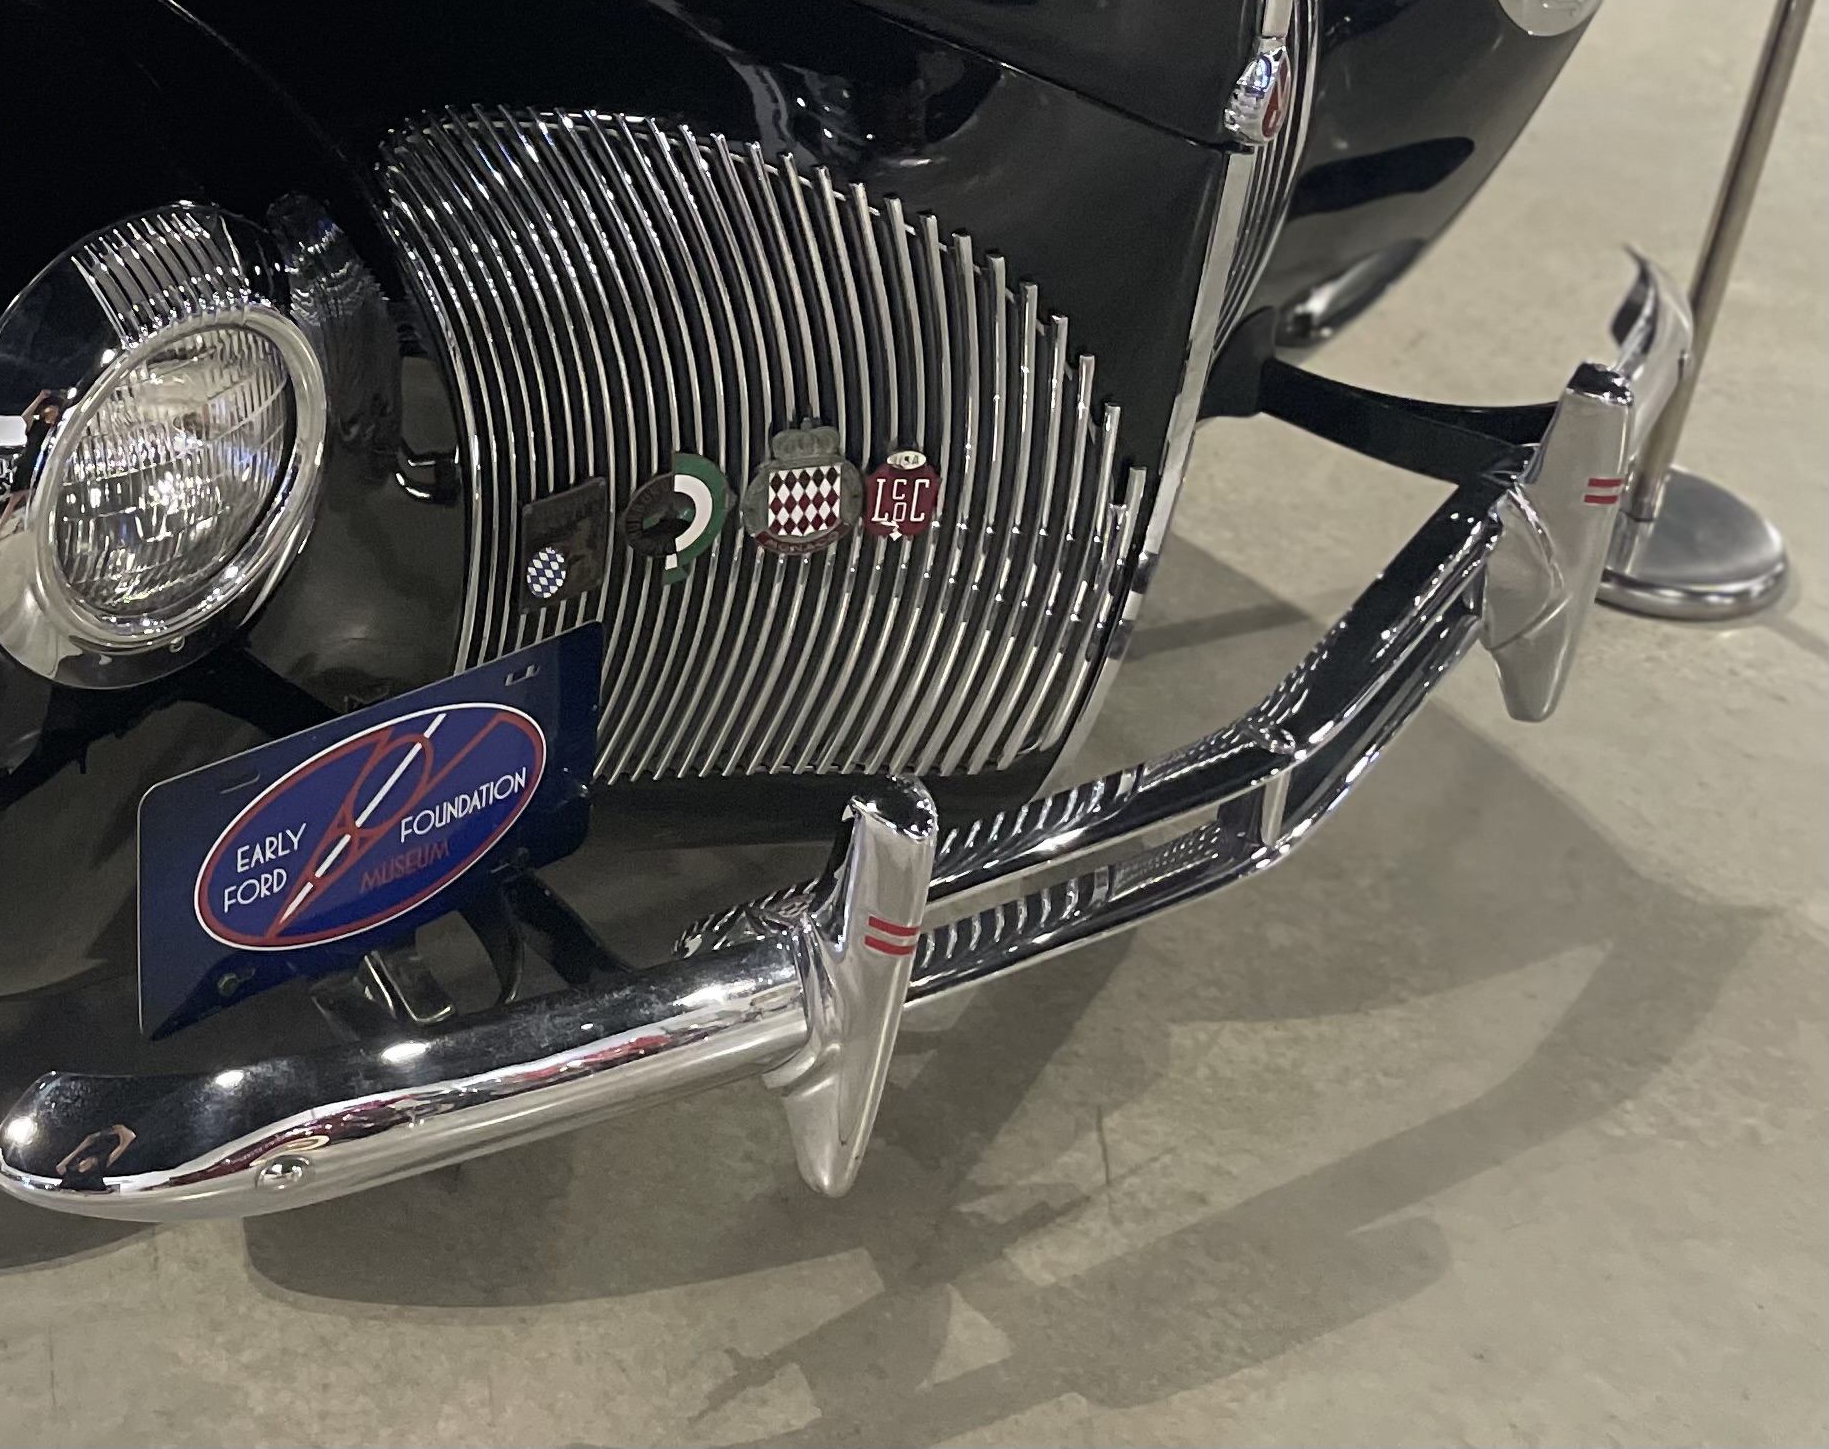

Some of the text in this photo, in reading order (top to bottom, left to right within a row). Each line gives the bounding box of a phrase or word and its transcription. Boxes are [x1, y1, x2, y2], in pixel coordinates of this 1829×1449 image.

[399, 766, 527, 844] FOUNDATION
[235, 822, 308, 873] EARLY
[359, 837, 450, 895] MUSEUM
[223, 867, 288, 914] FORD
